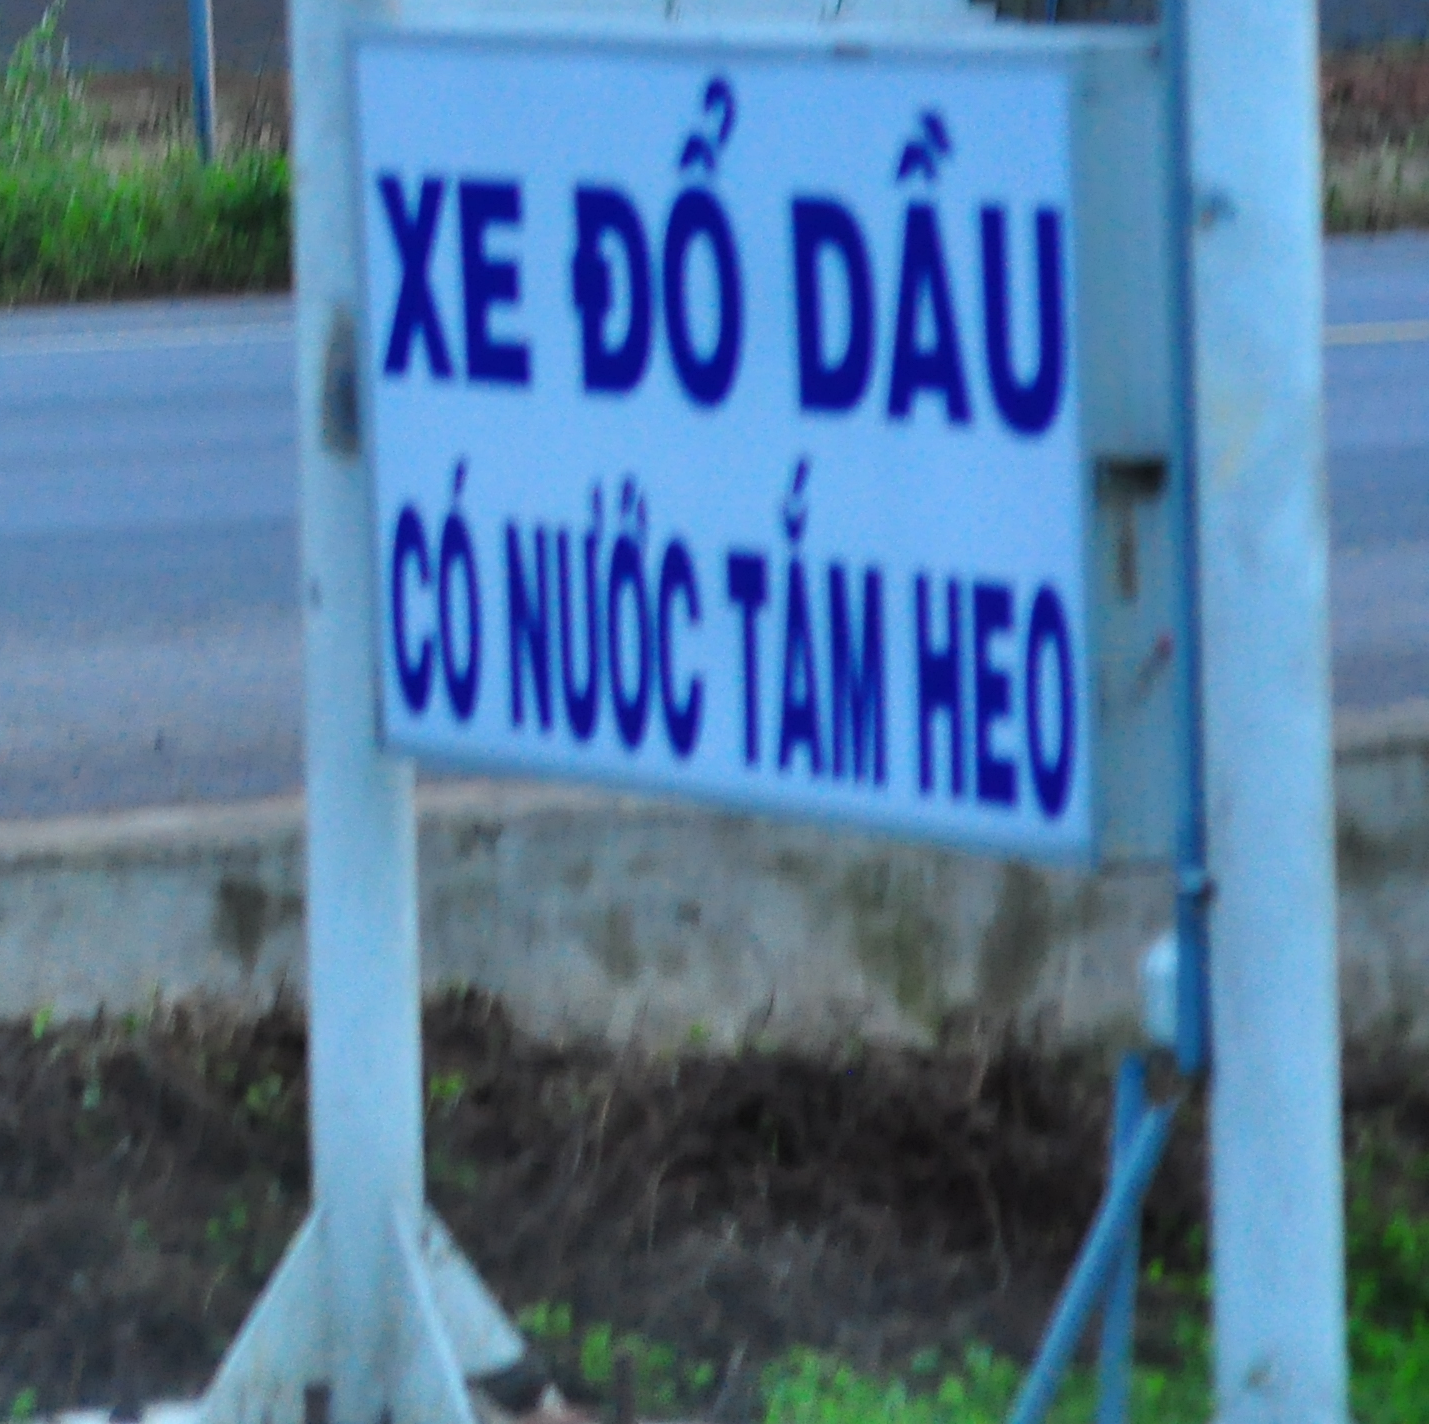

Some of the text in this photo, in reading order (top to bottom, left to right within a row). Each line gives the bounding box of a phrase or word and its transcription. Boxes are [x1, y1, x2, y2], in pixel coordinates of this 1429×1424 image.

[375, 74, 1071, 441] XE ĐỔ DẦU
[388, 456, 1079, 824] CÓ NƯỚC TẮM HEO
